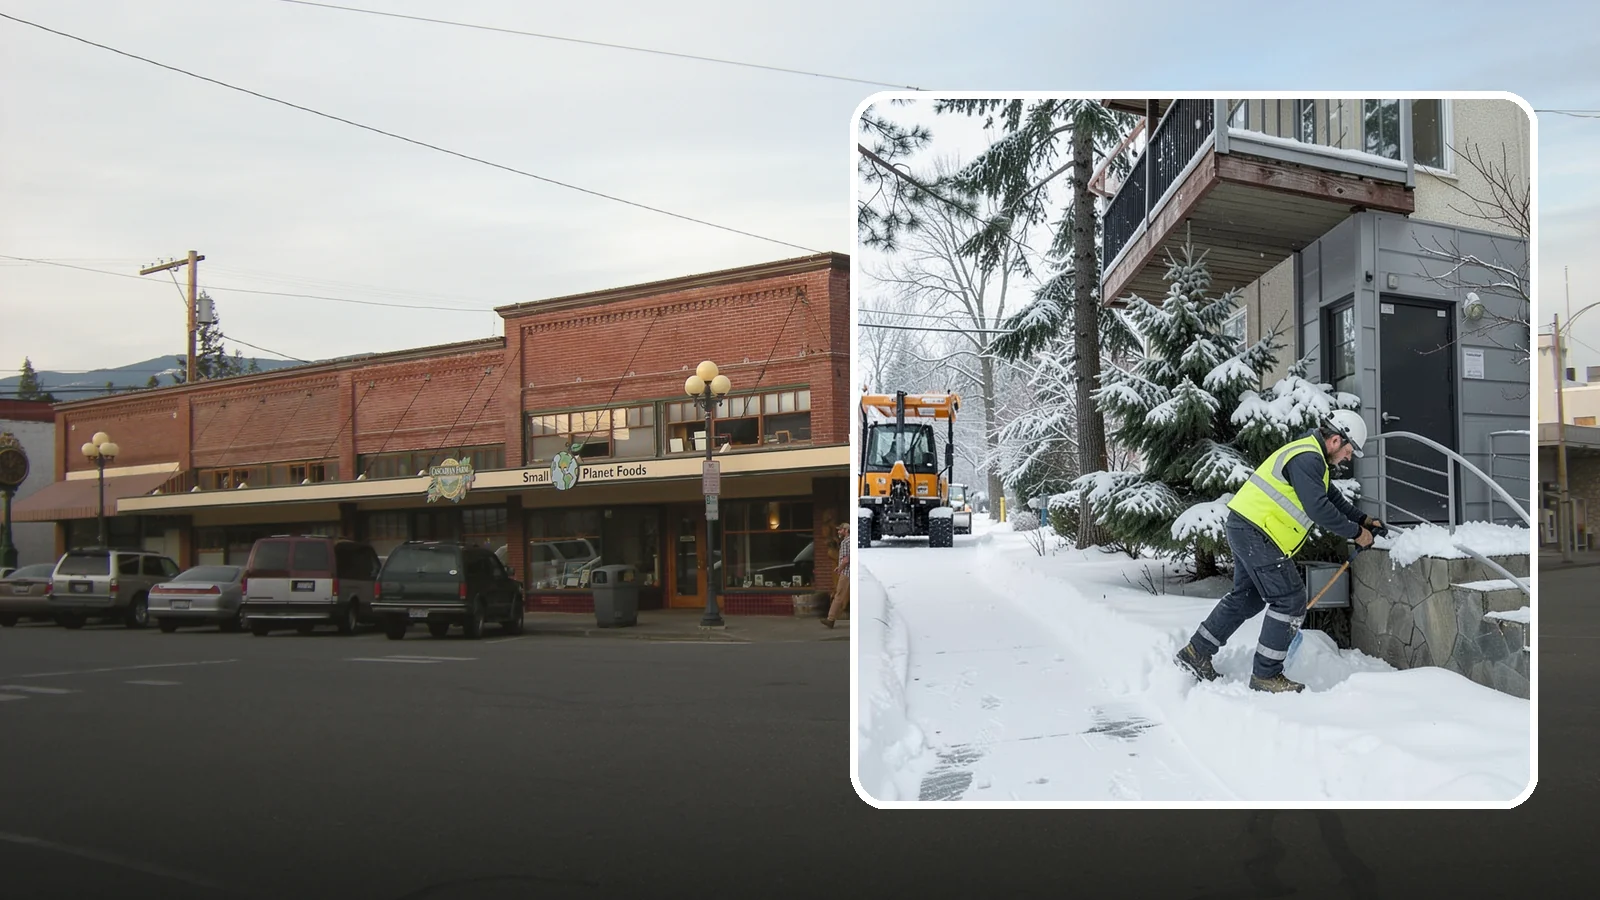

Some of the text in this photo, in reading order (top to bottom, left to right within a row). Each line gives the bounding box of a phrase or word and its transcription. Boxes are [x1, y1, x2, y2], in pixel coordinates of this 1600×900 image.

[523, 464, 647, 482] Small Planet Foods
